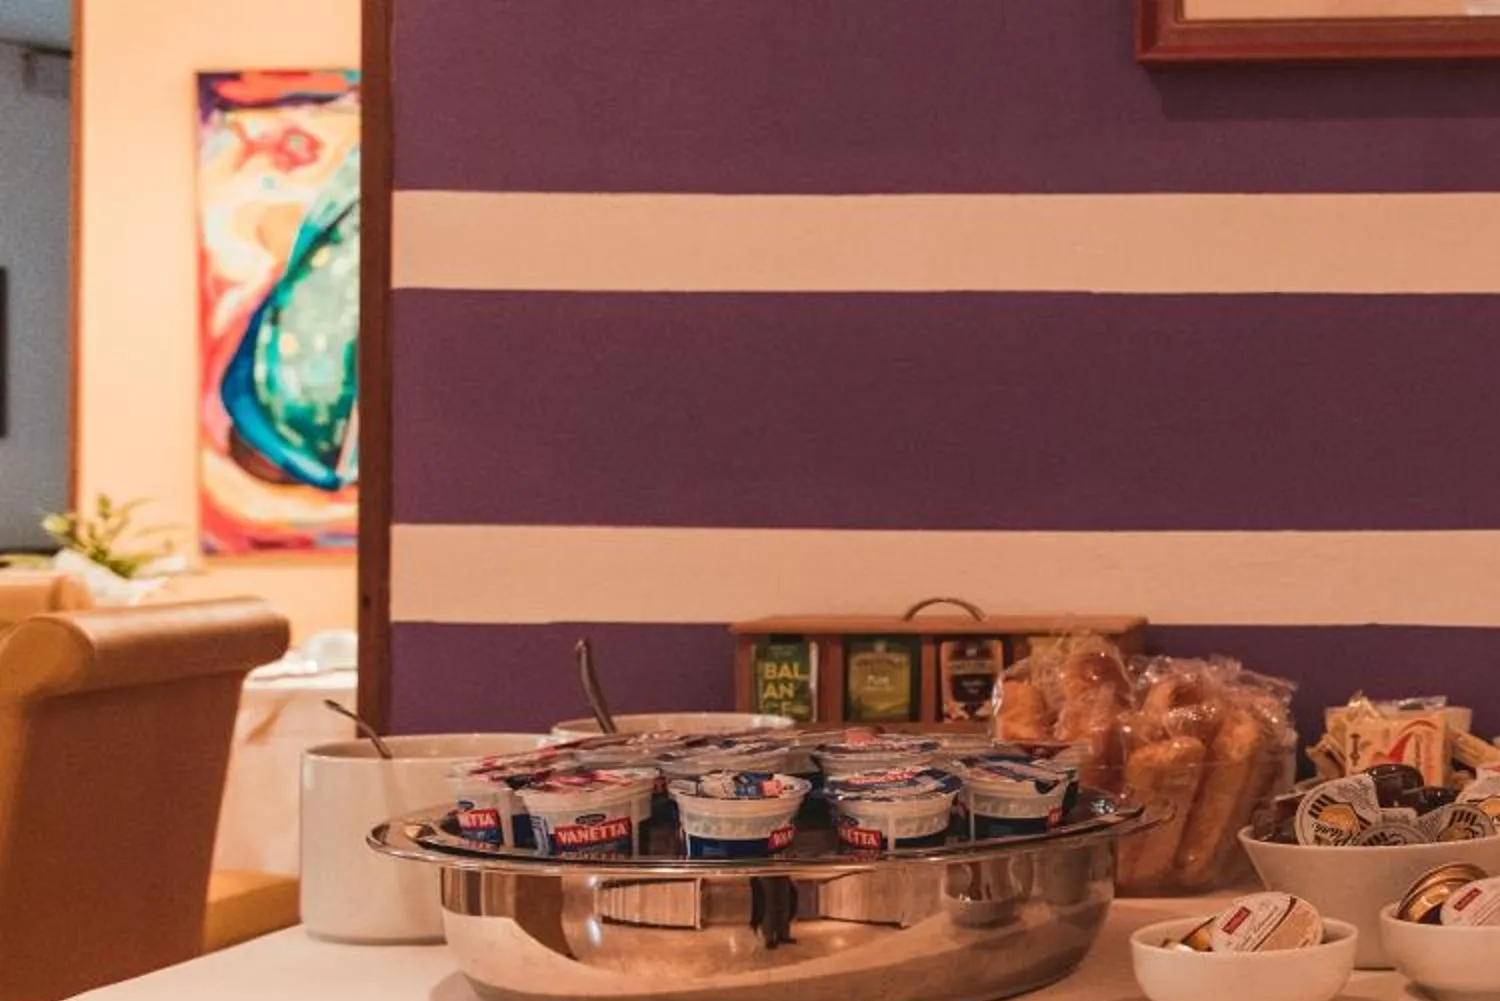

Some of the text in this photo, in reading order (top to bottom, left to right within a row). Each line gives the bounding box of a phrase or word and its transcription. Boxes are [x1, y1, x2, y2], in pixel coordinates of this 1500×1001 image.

[763, 661, 808, 679] BAL
[763, 681, 795, 700] AN
[556, 823, 629, 845] VANETTA
